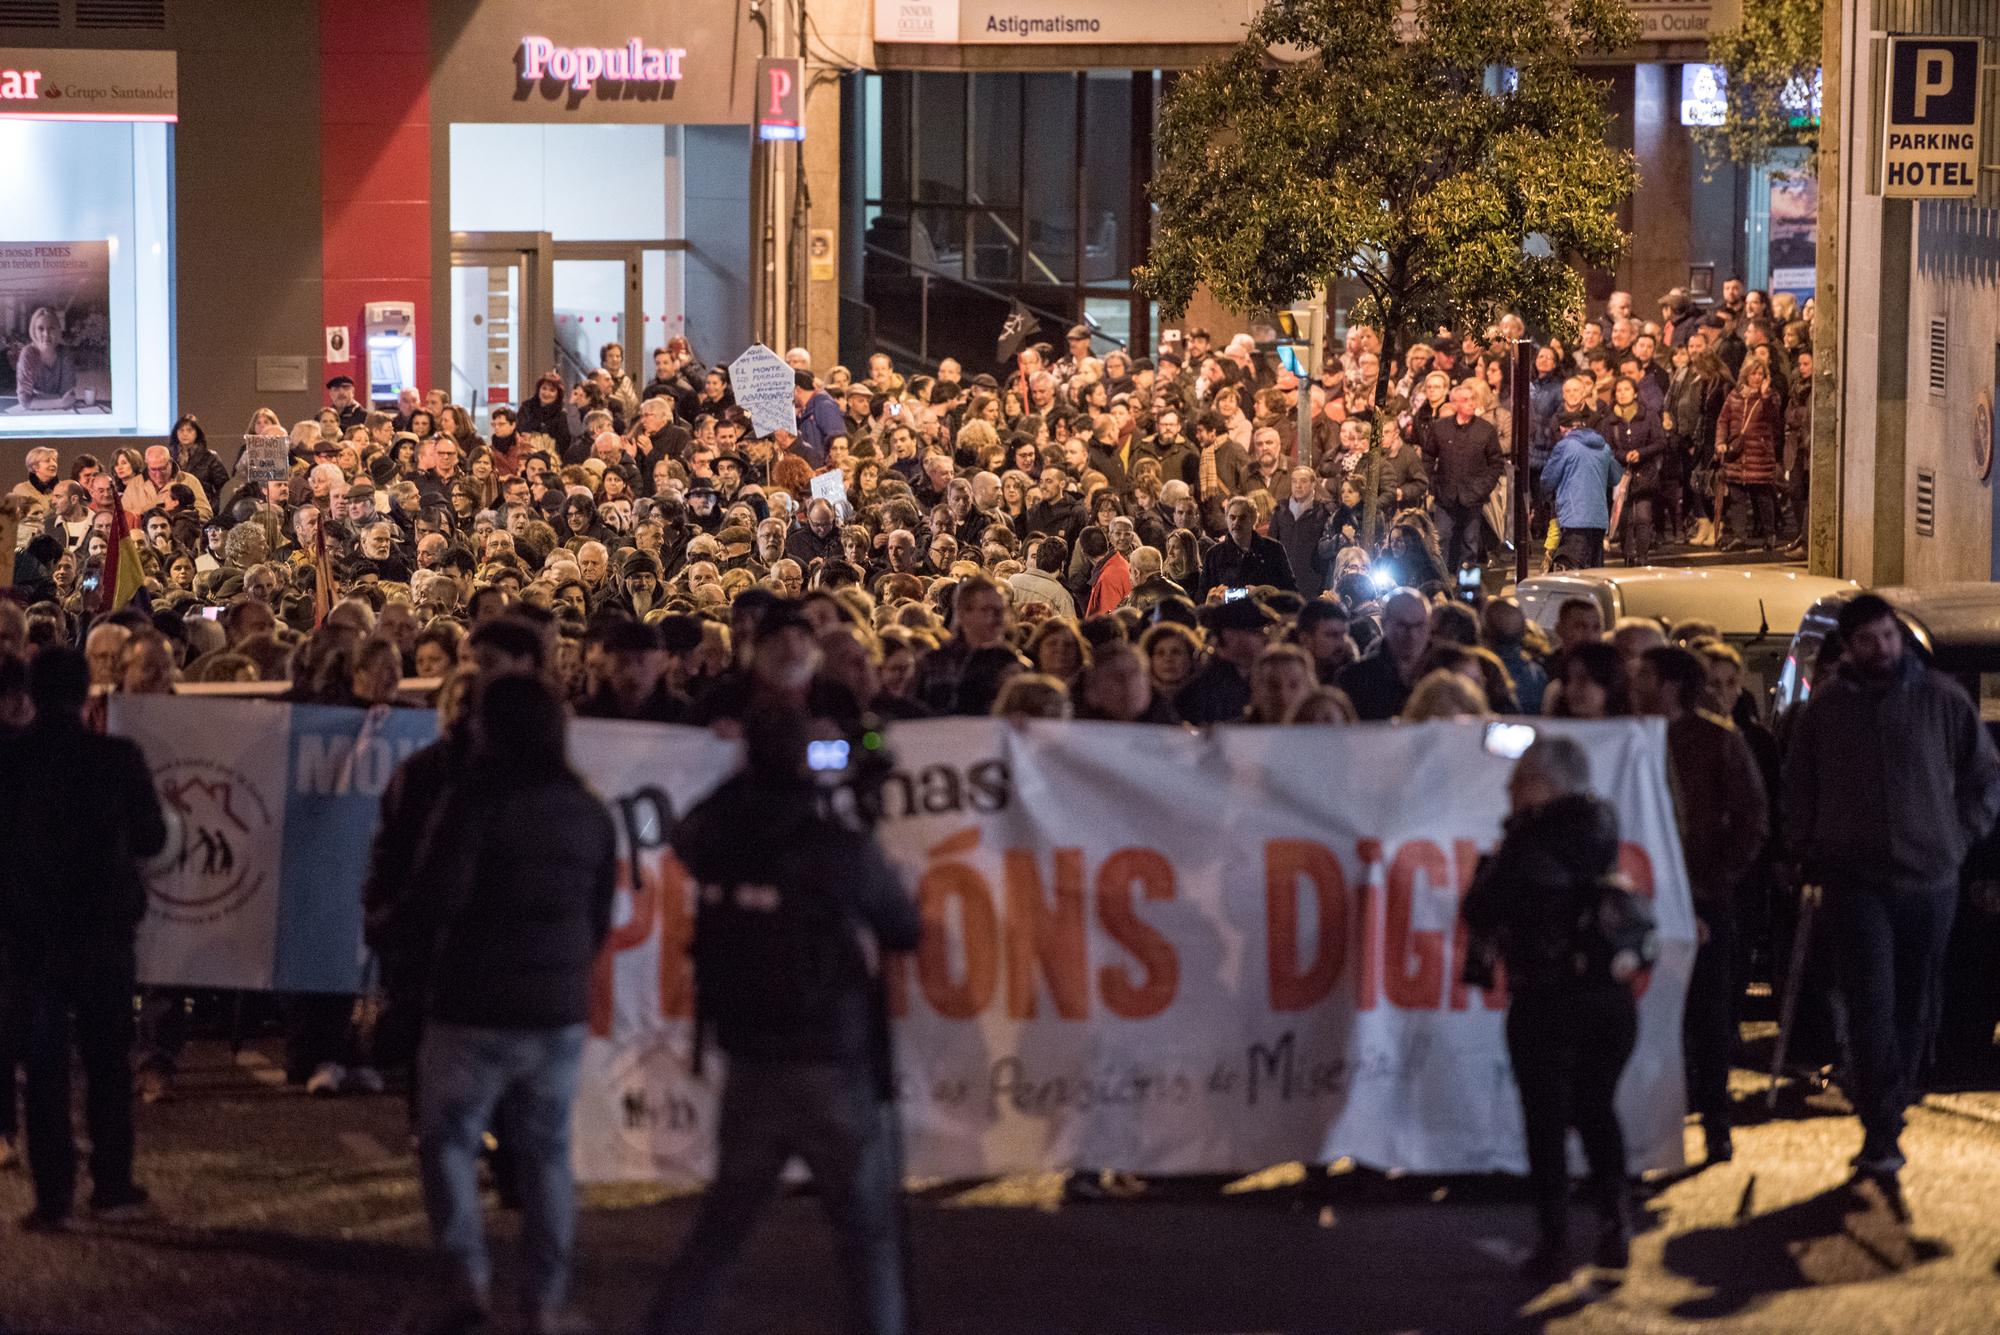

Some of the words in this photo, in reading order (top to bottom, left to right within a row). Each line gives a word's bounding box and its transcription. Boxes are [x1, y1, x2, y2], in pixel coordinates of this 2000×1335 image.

[986, 15, 1101, 36] Astigmatismo
[1661, 13, 1711, 31] Ocular
[522, 36, 687, 90] Popular
[0, 68, 42, 99] ar
[64, 83, 107, 101] Grupo
[111, 82, 175, 99] Santander
[768, 67, 792, 115] P
[1914, 48, 1954, 117] P
[1889, 133, 1974, 150] PARKING
[1888, 161, 1974, 186] HOTEL
[35, 246, 71, 257] PEMES
